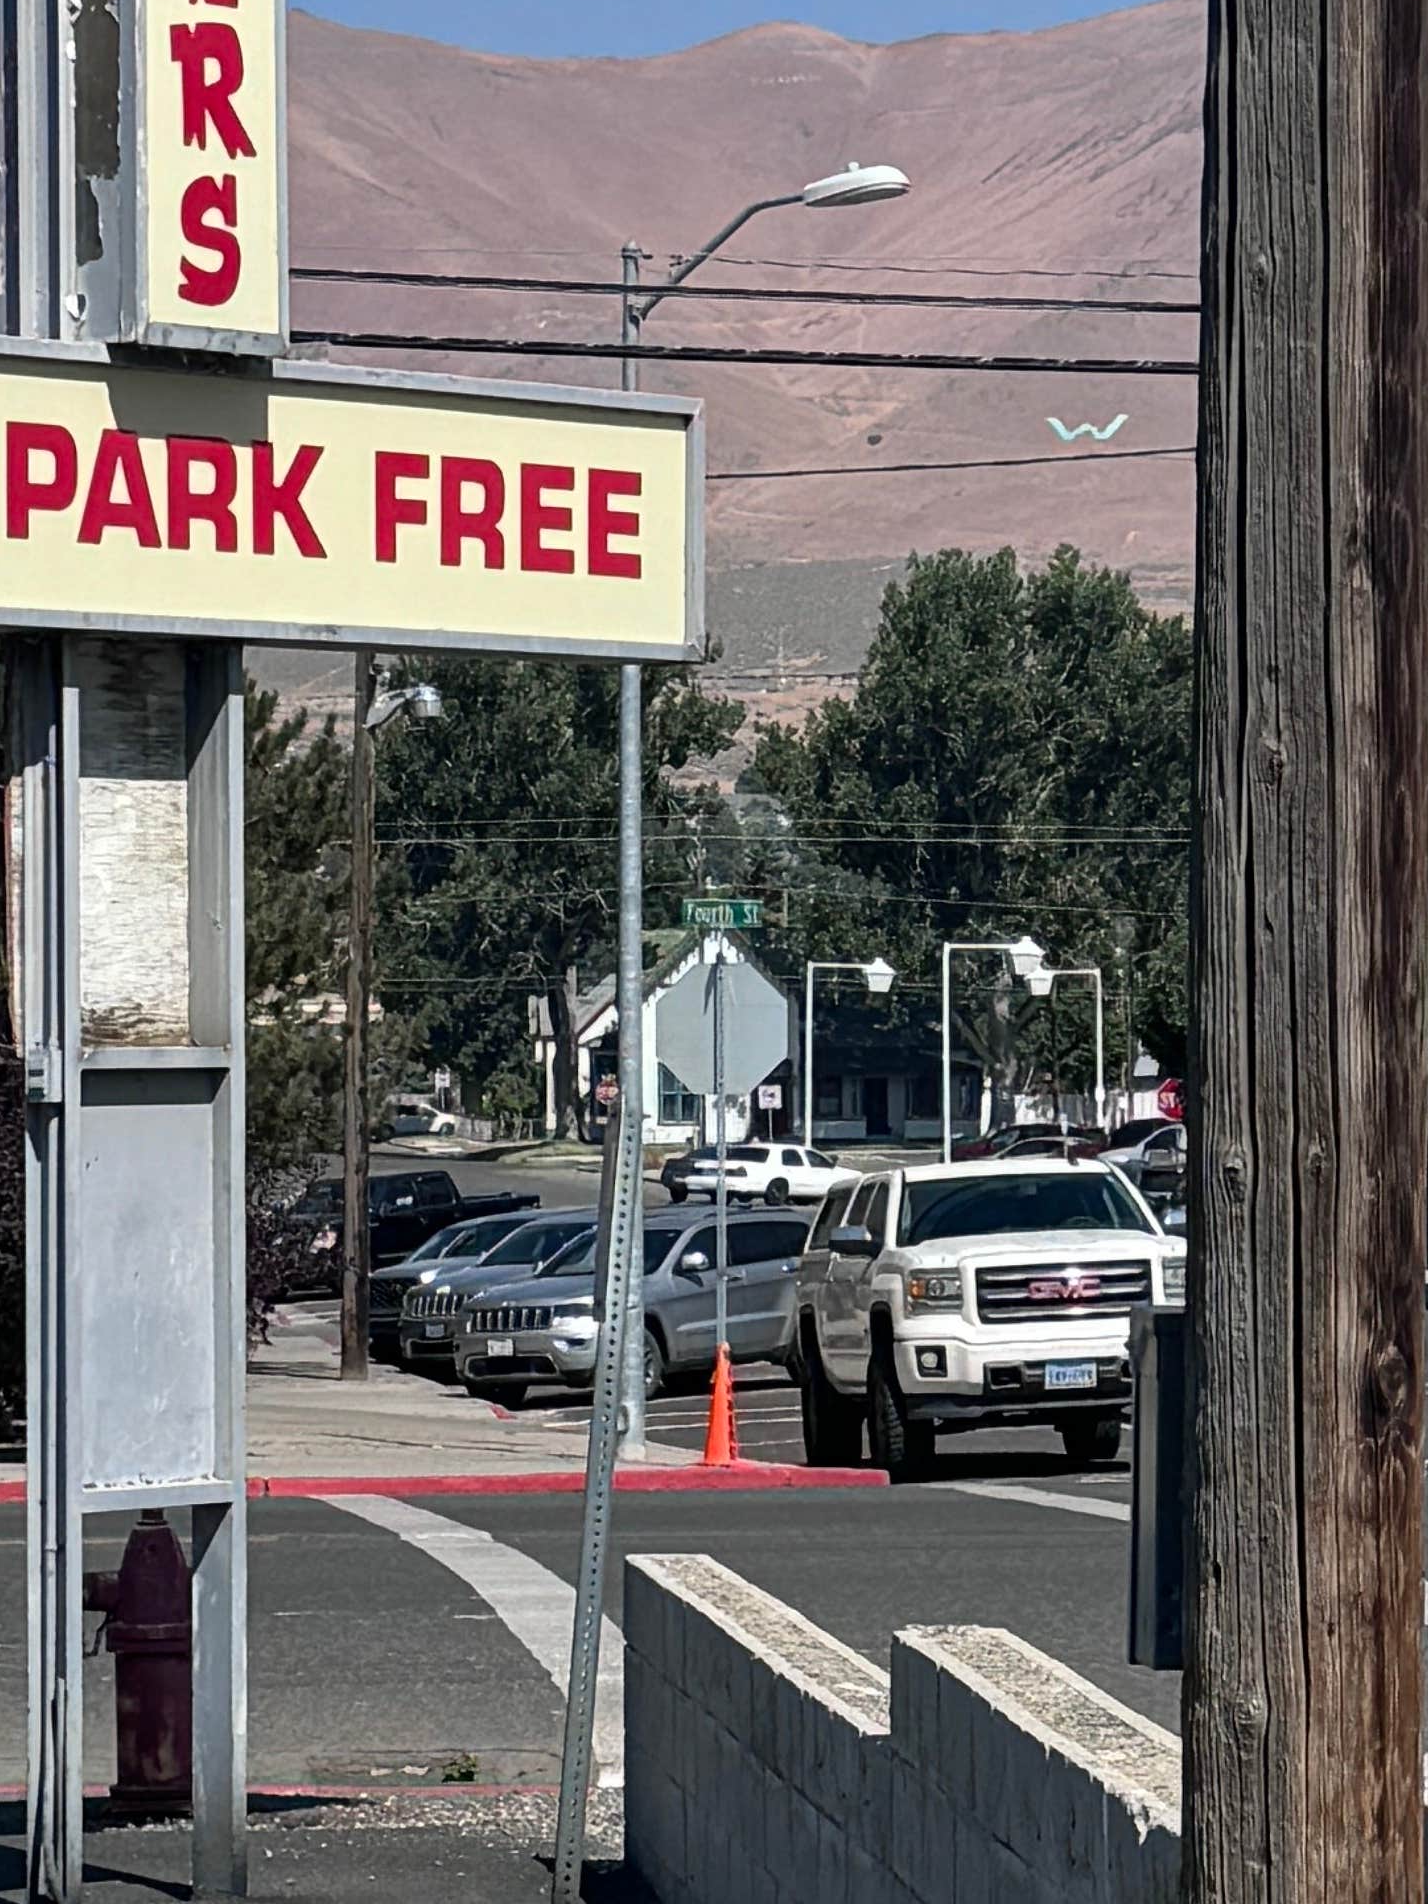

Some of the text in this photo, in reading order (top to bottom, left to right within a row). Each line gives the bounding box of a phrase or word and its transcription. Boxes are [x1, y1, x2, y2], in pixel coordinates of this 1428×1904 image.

[6, 421, 642, 580] PARK FREE
[1028, 1277, 1100, 1299] GMC
